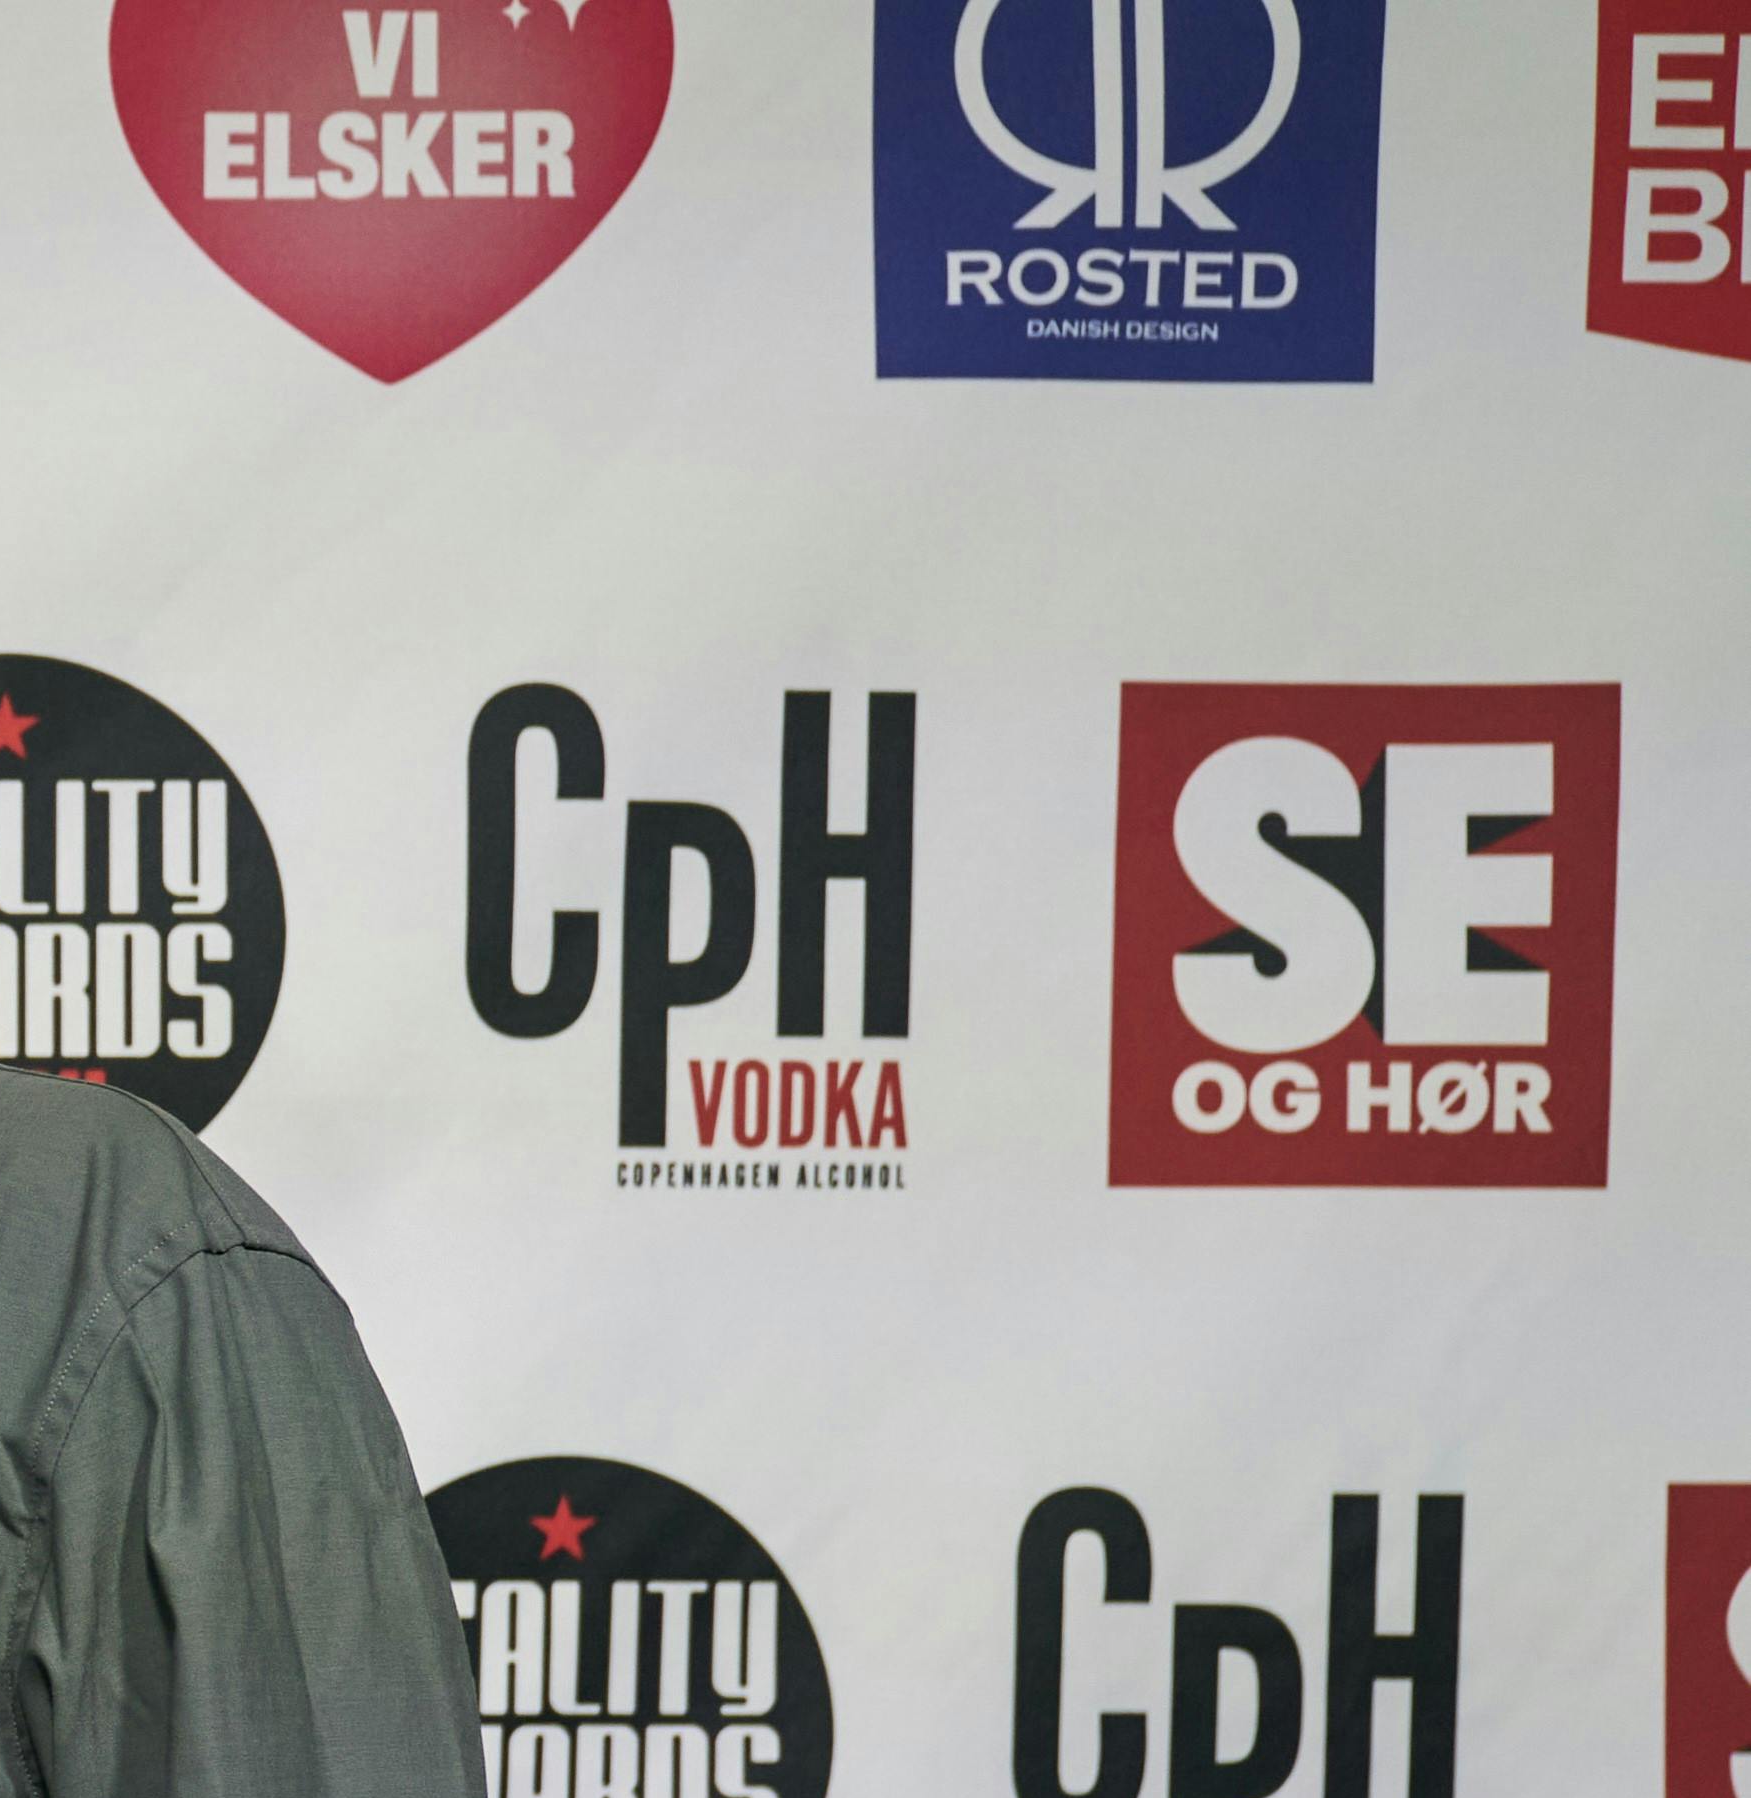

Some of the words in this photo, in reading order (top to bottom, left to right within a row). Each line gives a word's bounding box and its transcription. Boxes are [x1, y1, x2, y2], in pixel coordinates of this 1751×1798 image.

[343, 10, 441, 99] VI
[203, 110, 575, 200] ELSKER
[945, 249, 1299, 311] ROSTED
[1026, 319, 1121, 342] DANISH
[1125, 320, 1219, 345] DESIGN
[1170, 735, 1554, 1053] SE
[689, 1059, 909, 1149] VODKA
[1171, 1060, 1321, 1134] OG
[1345, 1060, 1553, 1136] HØR
[616, 1160, 782, 1188] COPENHAGEN
[795, 1160, 908, 1188] ALCOHOL
